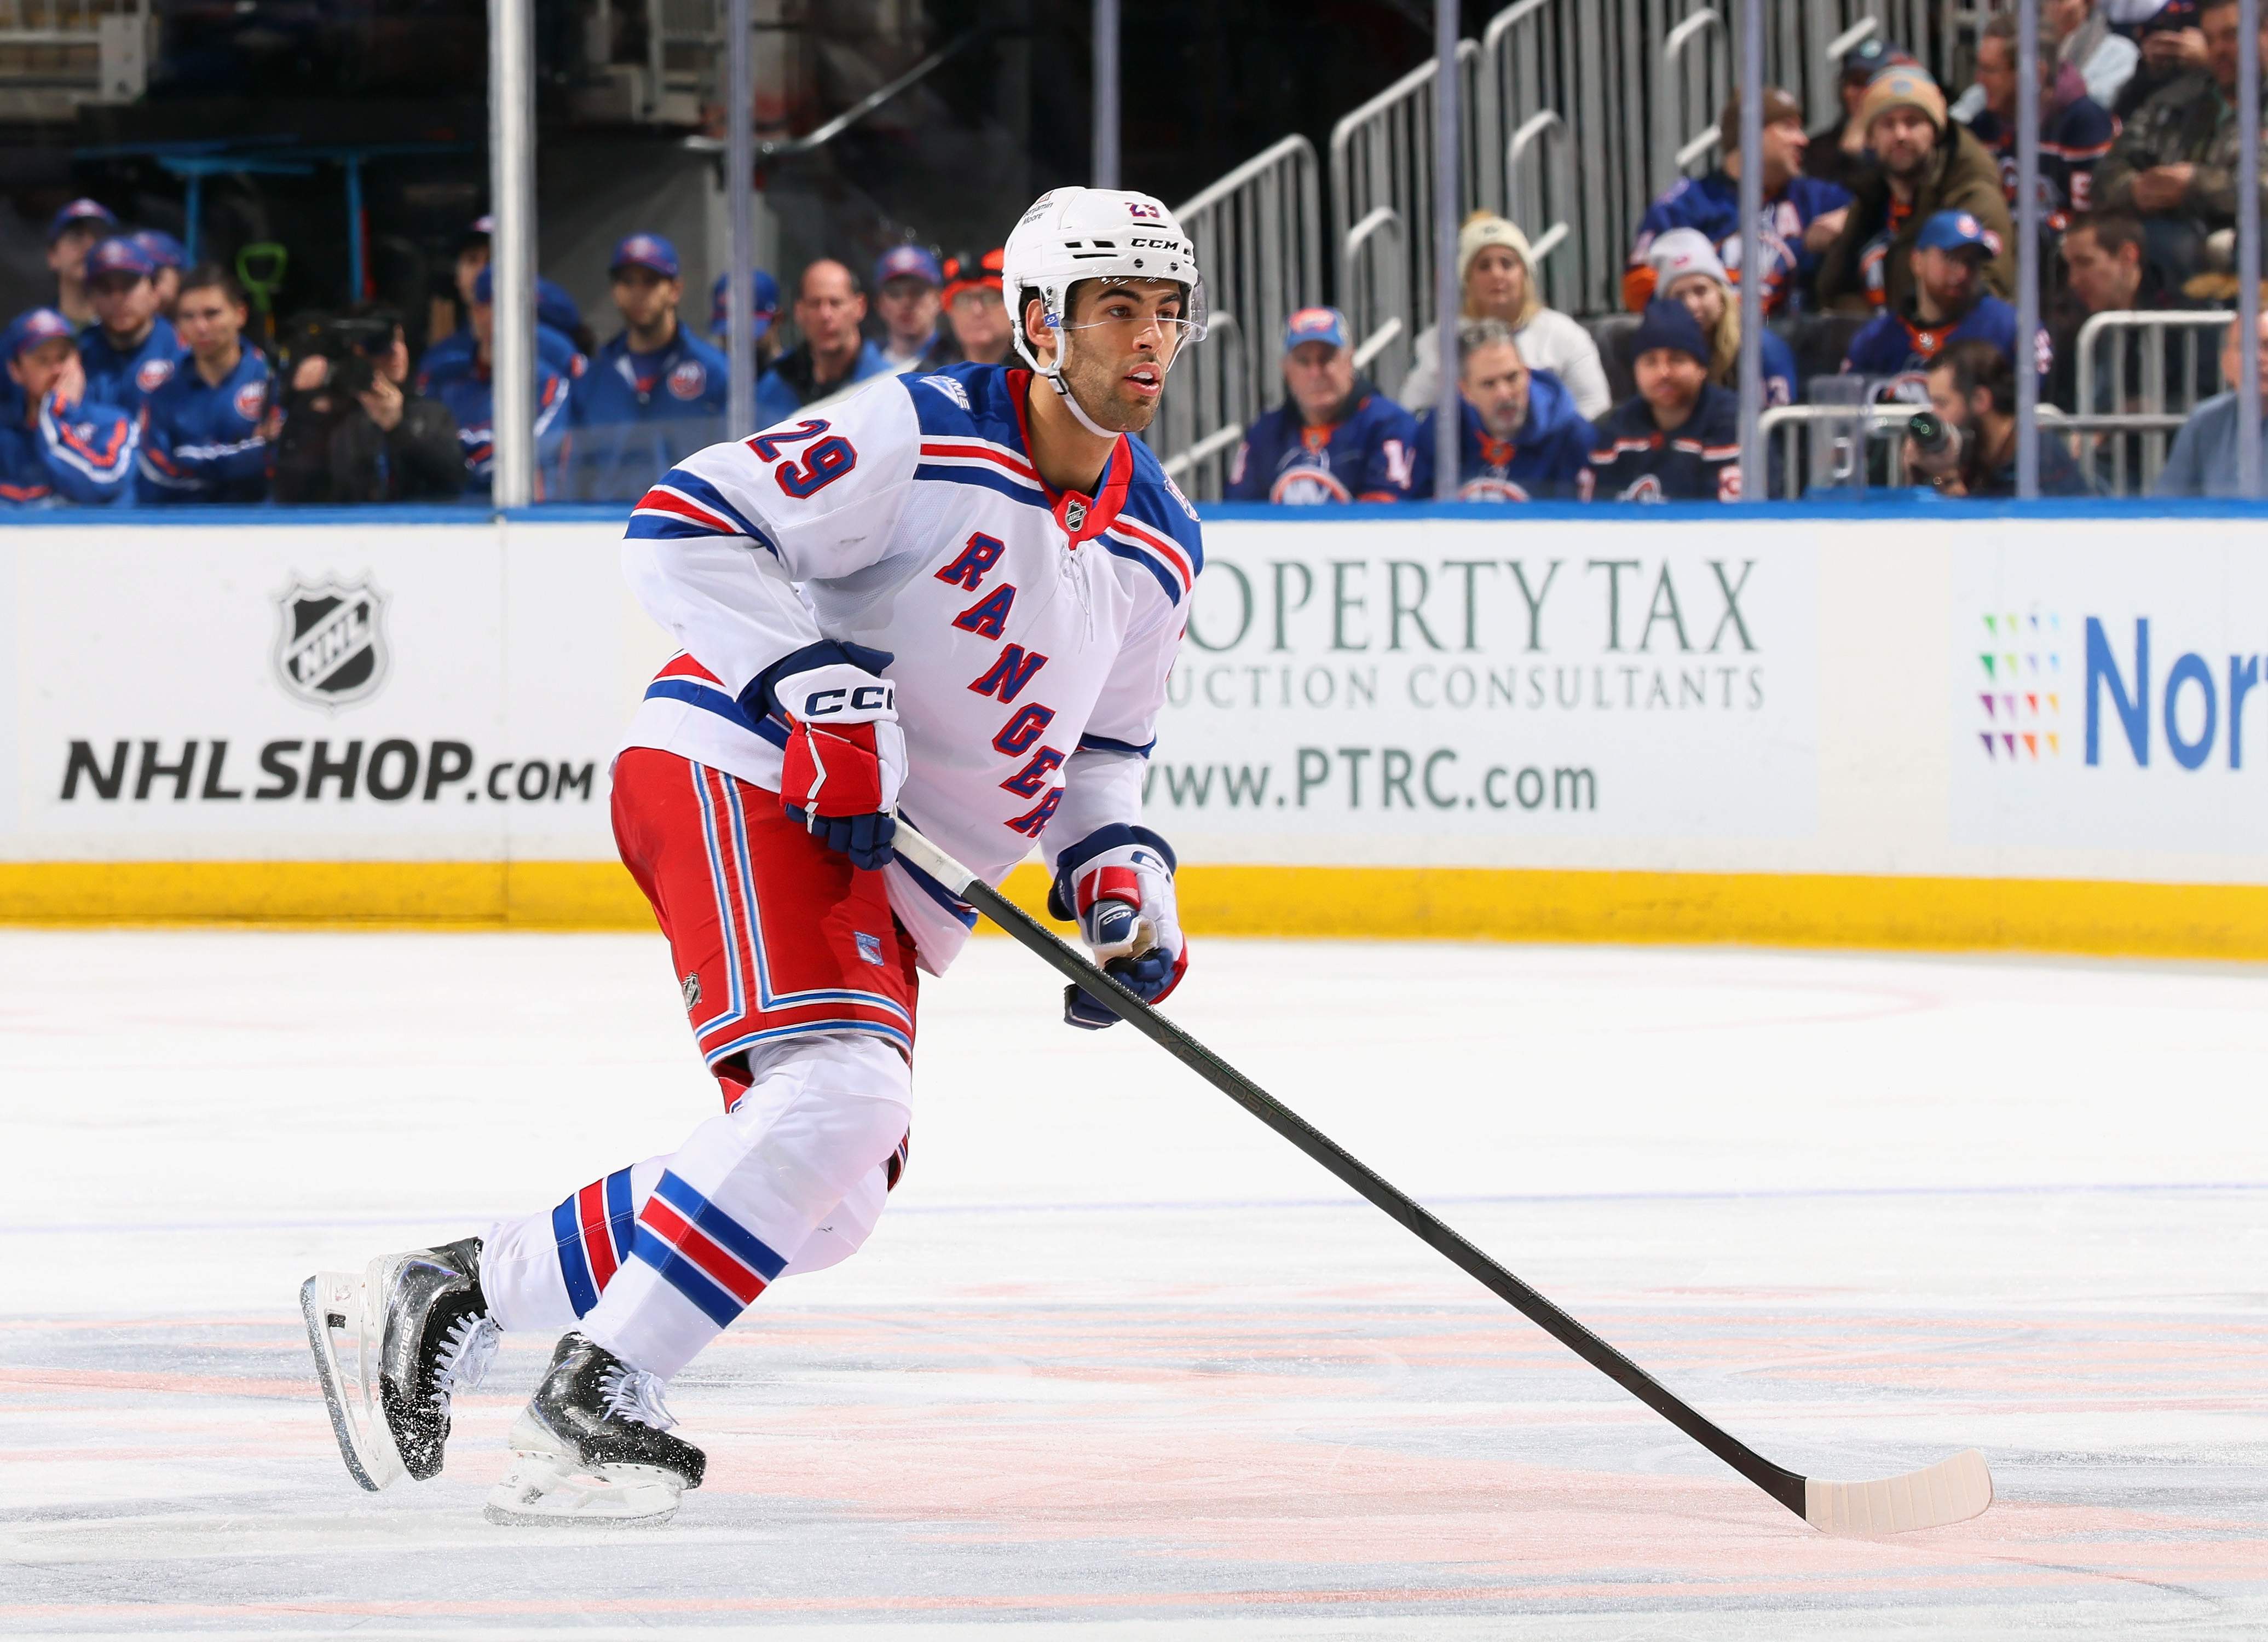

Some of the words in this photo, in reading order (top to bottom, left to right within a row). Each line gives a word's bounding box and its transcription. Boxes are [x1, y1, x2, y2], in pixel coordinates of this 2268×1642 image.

[1130, 238, 1179, 251] CCM
[745, 419, 858, 500] 29
[1588, 558, 1763, 653] TAX
[297, 609, 370, 683] NHL
[1408, 665, 1764, 710] CONSULTANTS
[2085, 615, 2268, 772] Nor
[1102, 911, 1132, 926] CCM
